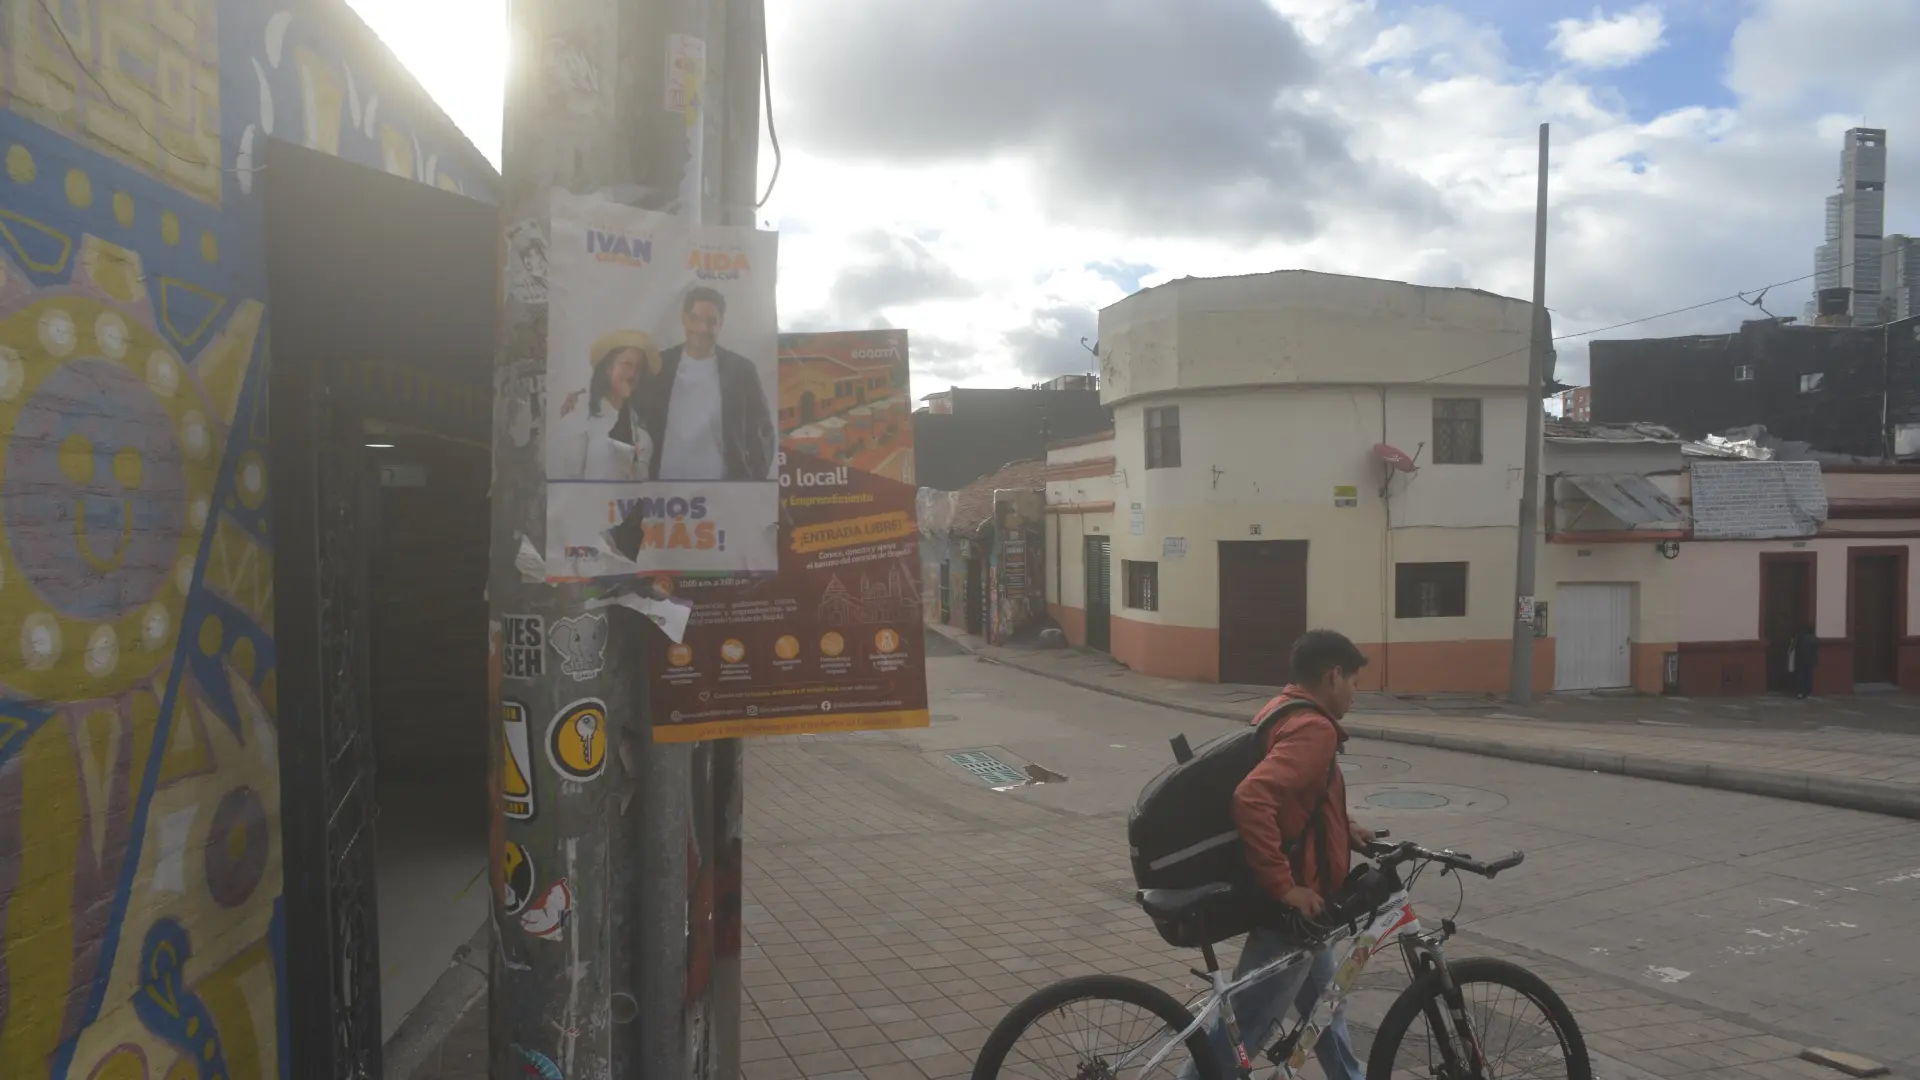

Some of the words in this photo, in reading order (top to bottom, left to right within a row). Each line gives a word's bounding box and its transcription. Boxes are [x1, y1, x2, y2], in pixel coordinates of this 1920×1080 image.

[687, 249, 751, 271] AIDA
[796, 466, 849, 487] local!
[607, 497, 707, 523] ¡VMOS
[790, 492, 874, 507] Emprendimiento
[800, 525, 863, 548] ¡ENTRADA
[865, 519, 902, 537] LIBRE!
